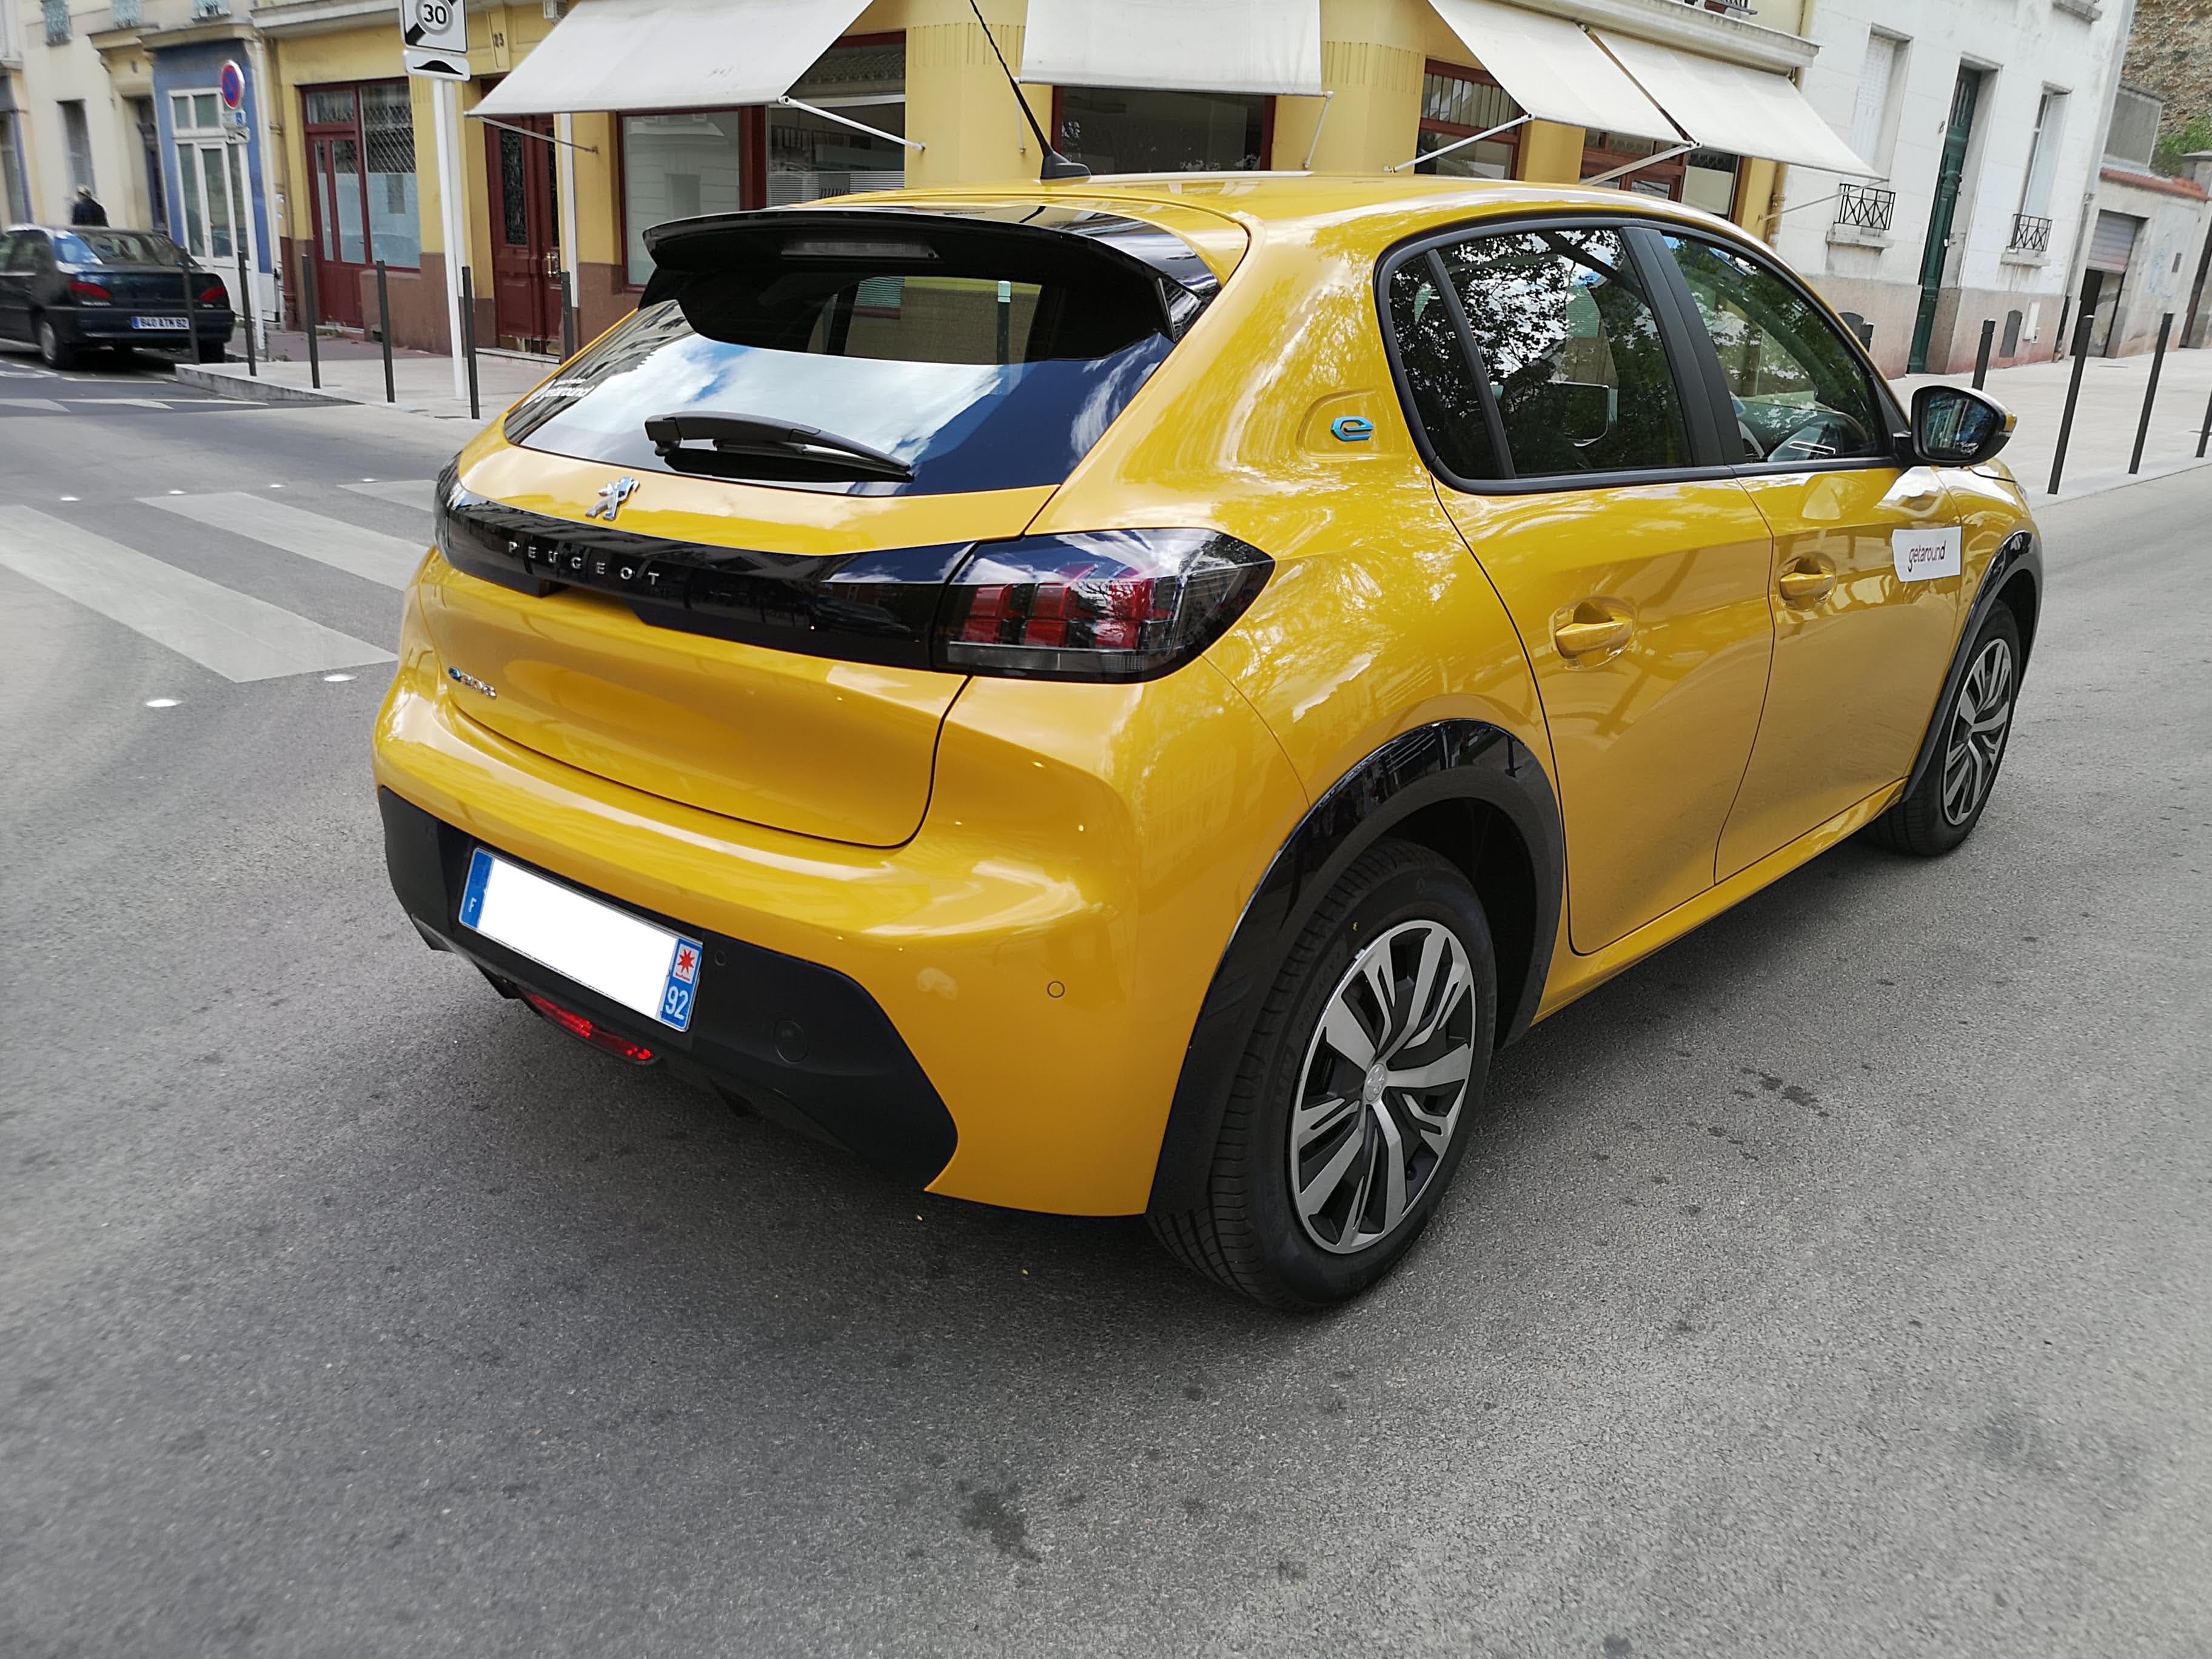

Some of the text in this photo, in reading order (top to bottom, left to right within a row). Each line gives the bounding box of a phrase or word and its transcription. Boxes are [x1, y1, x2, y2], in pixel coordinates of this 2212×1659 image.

[423, 4, 447, 24] 30
[1939, 121, 1946, 134] 8
[508, 541, 660, 585] PEUGEOT
[1908, 540, 1946, 573] getaround
[468, 897, 477, 913] F
[665, 986, 689, 1020] 92
